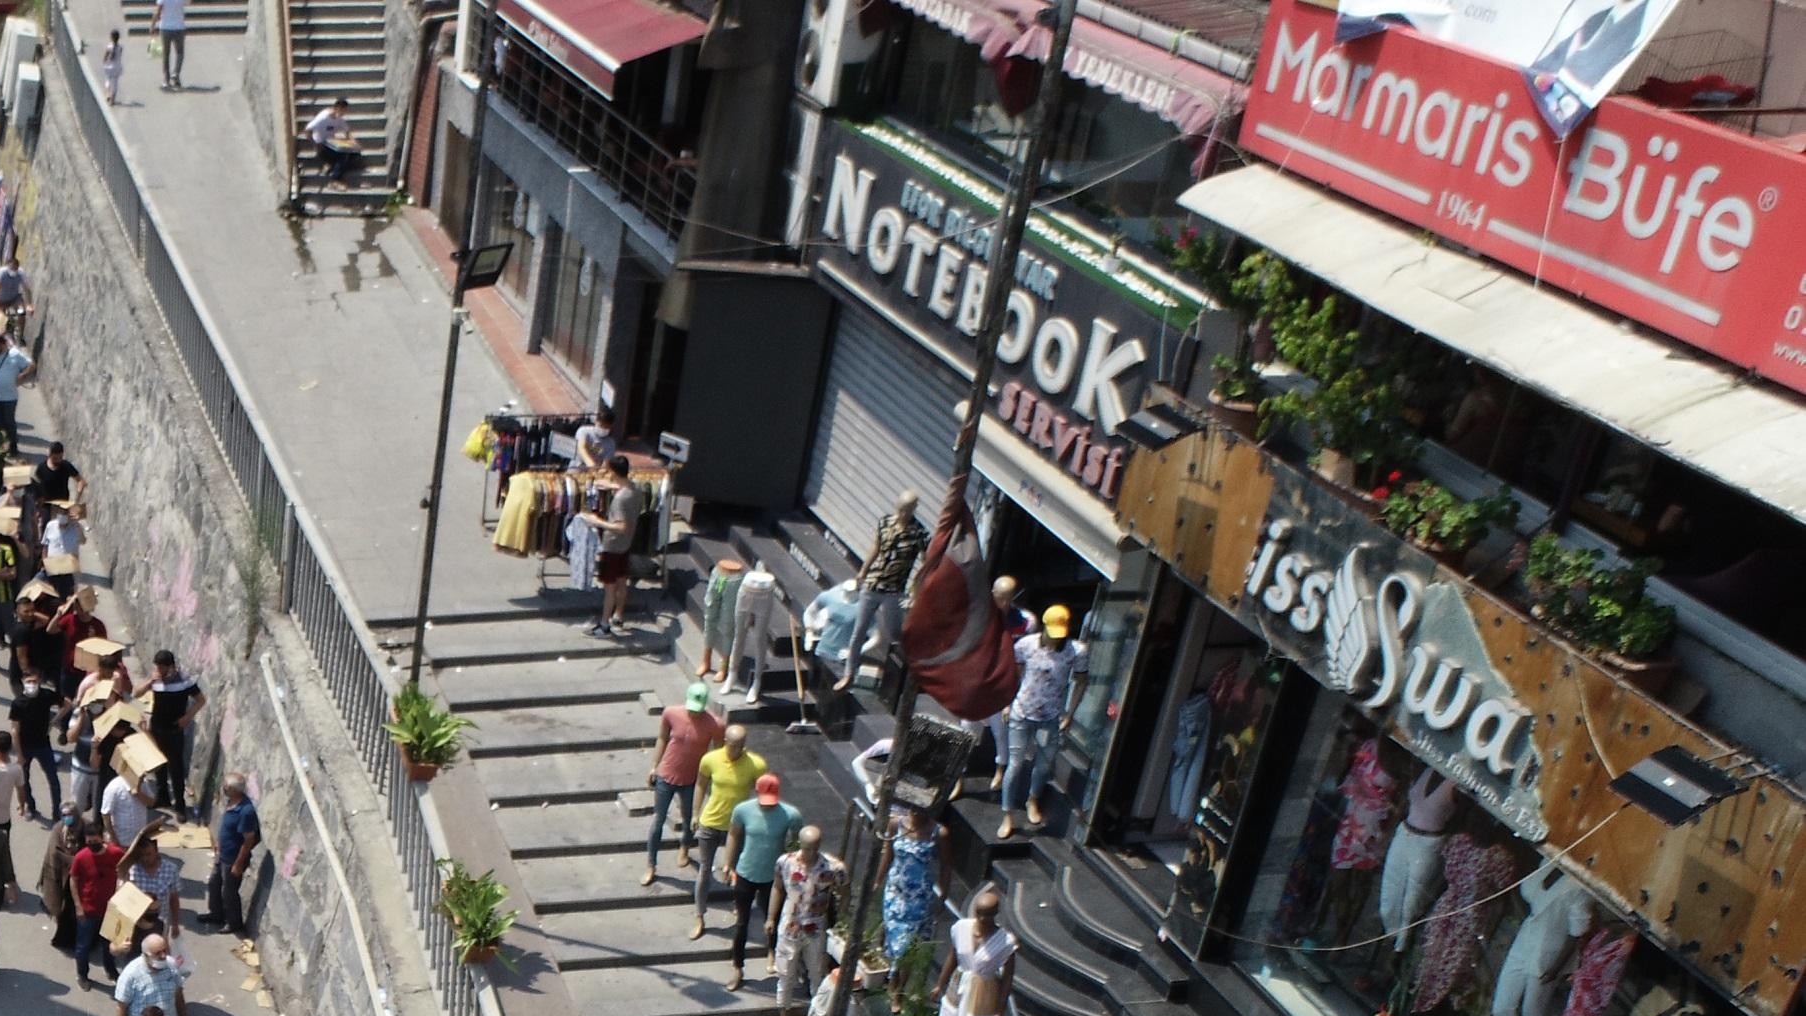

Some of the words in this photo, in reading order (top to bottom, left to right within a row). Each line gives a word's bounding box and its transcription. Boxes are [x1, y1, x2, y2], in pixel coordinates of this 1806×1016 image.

[1264, 19, 1539, 188] Marmaris
[1562, 127, 1753, 274] Büfe
[1434, 188, 1488, 234] 1964
